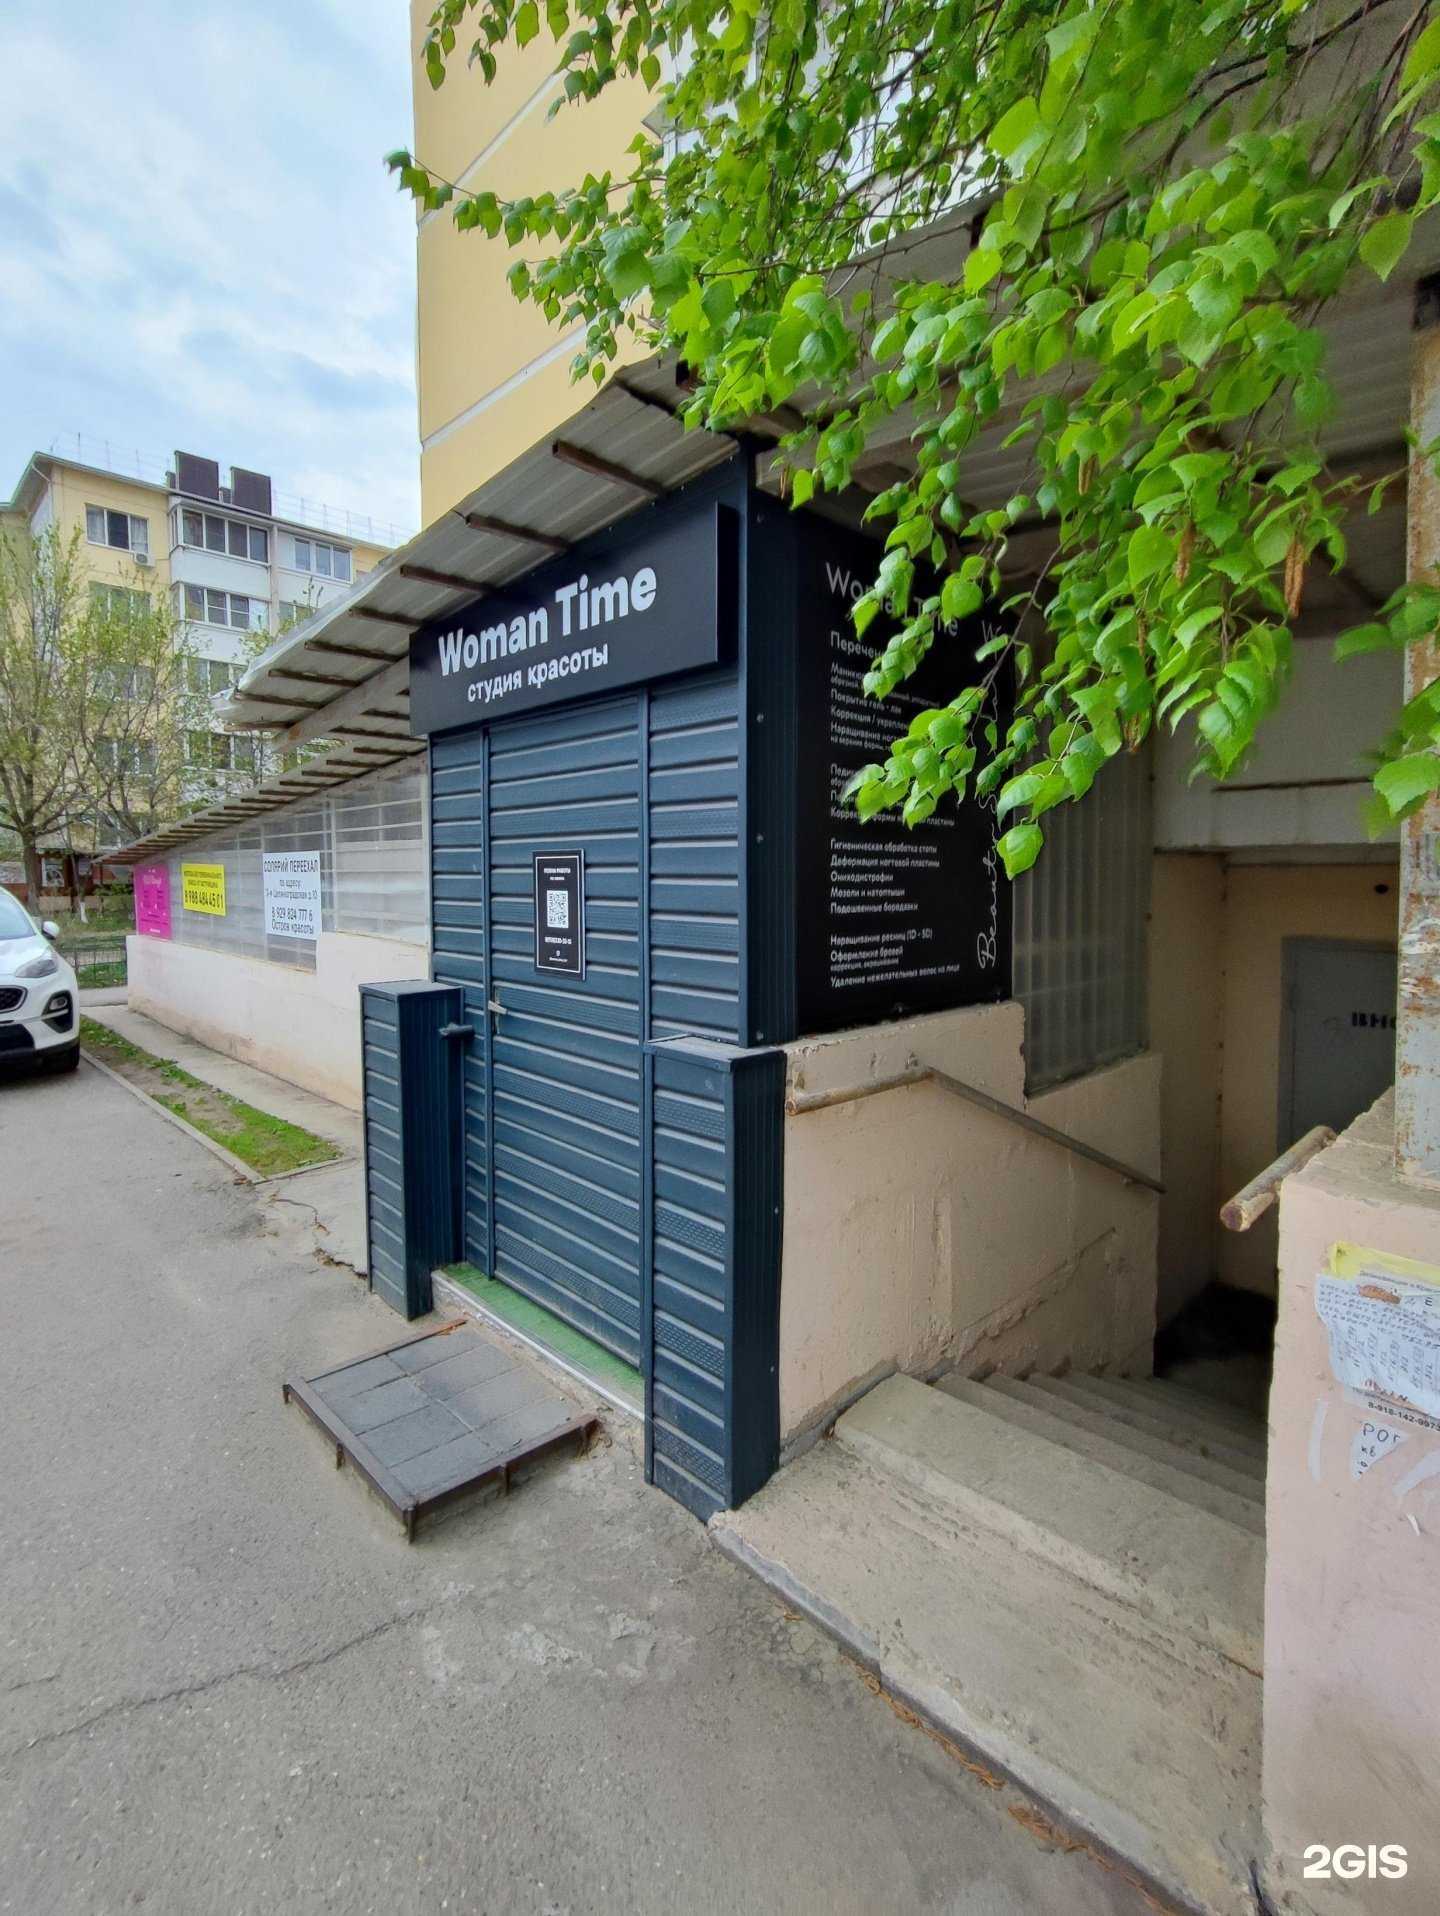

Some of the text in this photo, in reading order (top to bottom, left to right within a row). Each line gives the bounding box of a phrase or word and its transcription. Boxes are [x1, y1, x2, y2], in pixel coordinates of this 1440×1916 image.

[438, 567, 657, 677] Woman Time
[467, 643, 609, 704] студия красоты
[831, 837, 883, 852] Гигиеническая
[884, 841, 919, 854] обработка
[290, 859, 319, 873] ПЕРЕЕХАЛ
[831, 854, 940, 868] Деформация ногтевой пластины
[830, 885, 860, 898] Мозоли
[867, 889, 905, 897] натоптыши
[830, 901, 918, 914] Подошвенные бородавки
[271, 919, 314, 935] Остров красоты
[830, 934, 880, 946] Наращивание
[881, 932, 906, 943] ресниц
[830, 945, 904, 963] Оформление бровей
[830, 975, 866, 989] Удаление
[867, 969, 918, 983] нежелательных
[919, 966, 937, 976] волос
